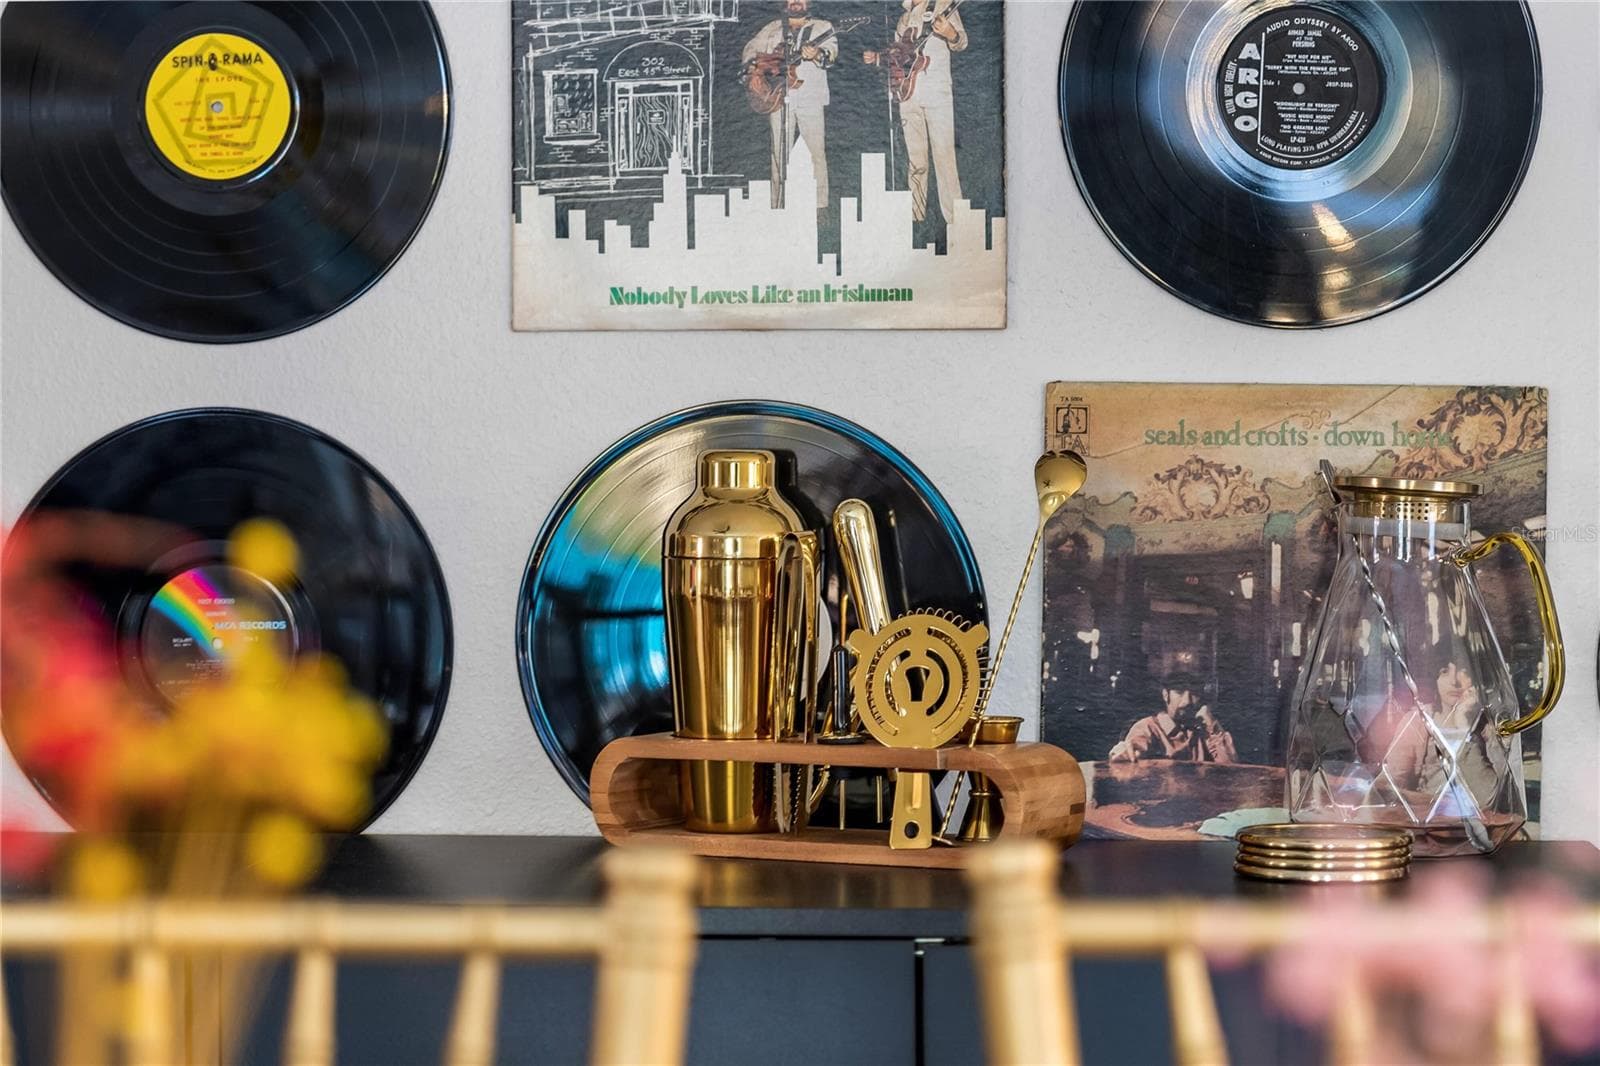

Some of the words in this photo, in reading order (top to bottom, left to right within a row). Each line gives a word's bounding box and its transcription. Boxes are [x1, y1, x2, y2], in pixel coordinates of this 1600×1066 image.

[1266, 19, 1290, 34] AUDIO
[1294, 18, 1330, 29] ODYSSEY
[1331, 26, 1342, 34] BY
[1340, 33, 1359, 51] ARGO
[618, 68, 640, 77] East
[662, 65, 691, 75] Street
[642, 57, 665, 67] 302
[1234, 43, 1261, 132] ARGO
[609, 286, 687, 309] Nobody
[691, 285, 748, 305] Loves
[751, 284, 794, 304] Like
[797, 288, 821, 303] an
[823, 283, 914, 302] Irishman
[1144, 419, 1198, 446] seals
[1201, 420, 1242, 446] and
[1244, 419, 1308, 447] crofts
[1324, 420, 1385, 447] down
[240, 620, 287, 630] RECORDS
